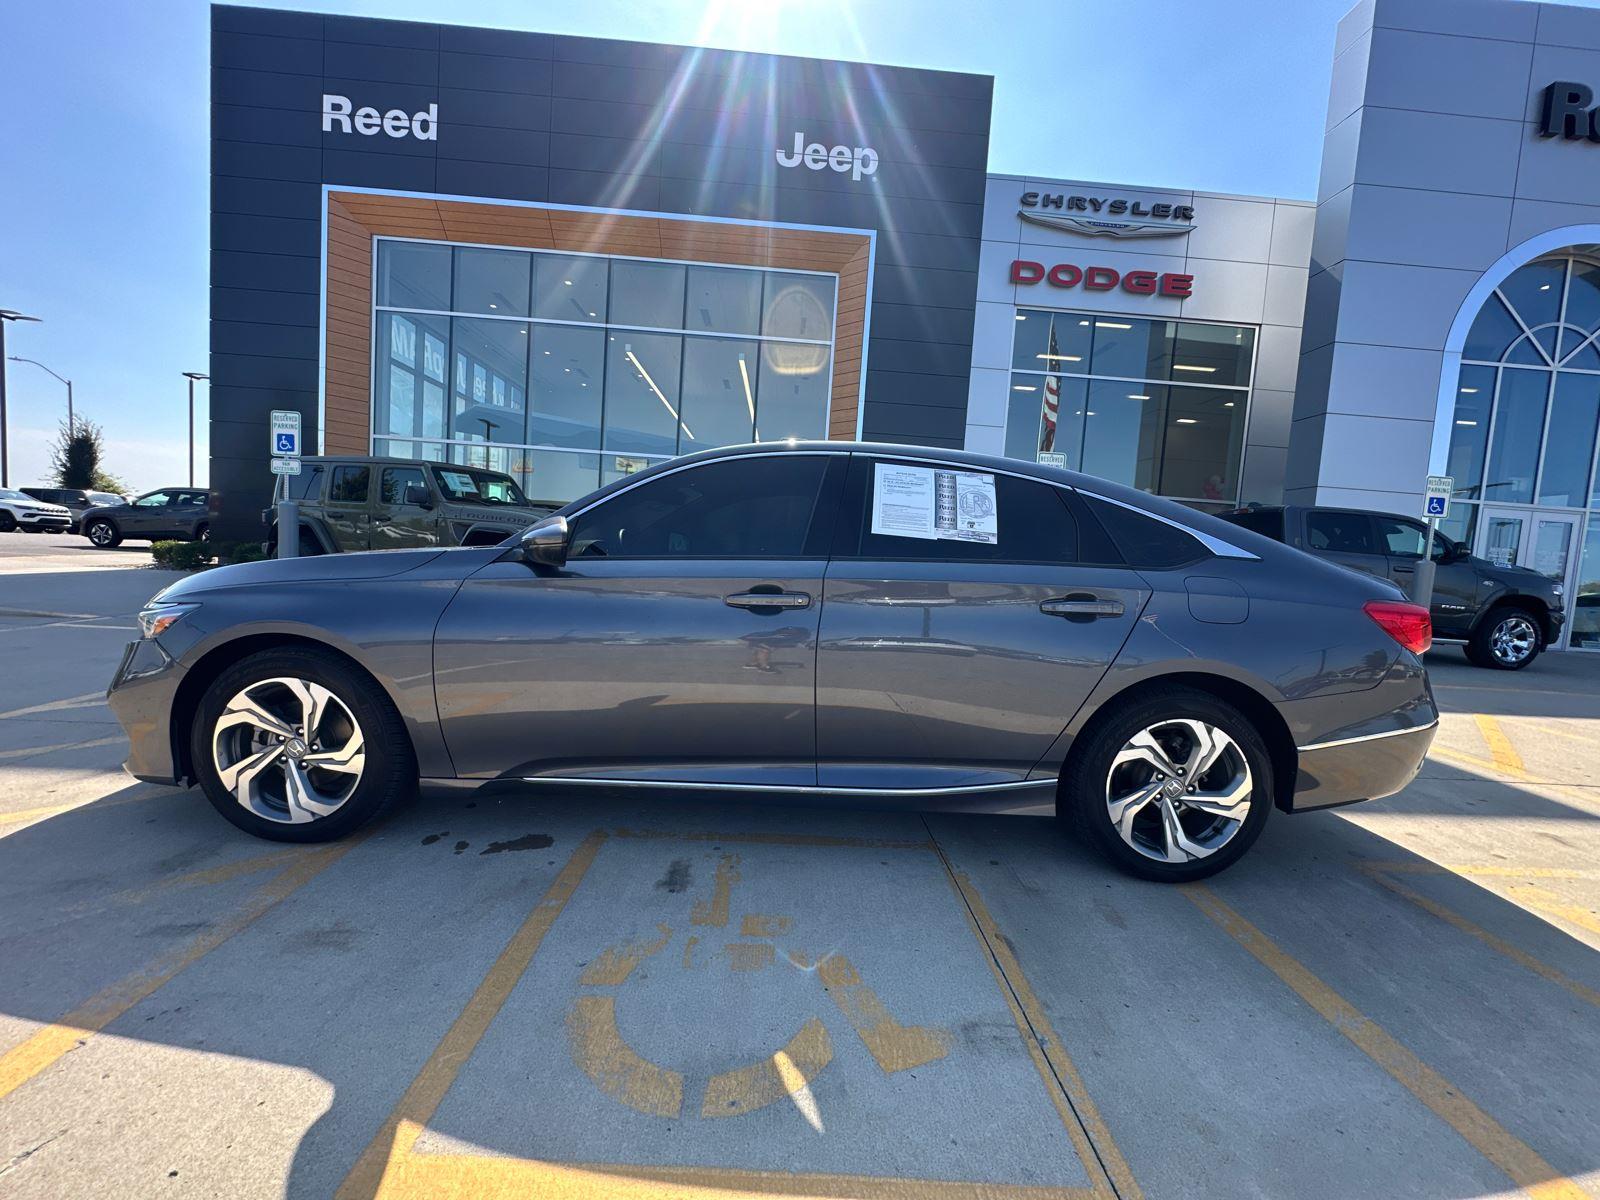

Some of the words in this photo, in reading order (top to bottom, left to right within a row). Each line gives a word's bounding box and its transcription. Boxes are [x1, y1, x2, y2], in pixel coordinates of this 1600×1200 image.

[322, 94, 438, 140] Reed
[776, 132, 879, 181] Jeep
[1021, 192, 1194, 219] CHRYSLER
[1011, 260, 1193, 299] DODGE
[273, 422, 298, 430] PARKING
[1040, 455, 1064, 463] RESERVED
